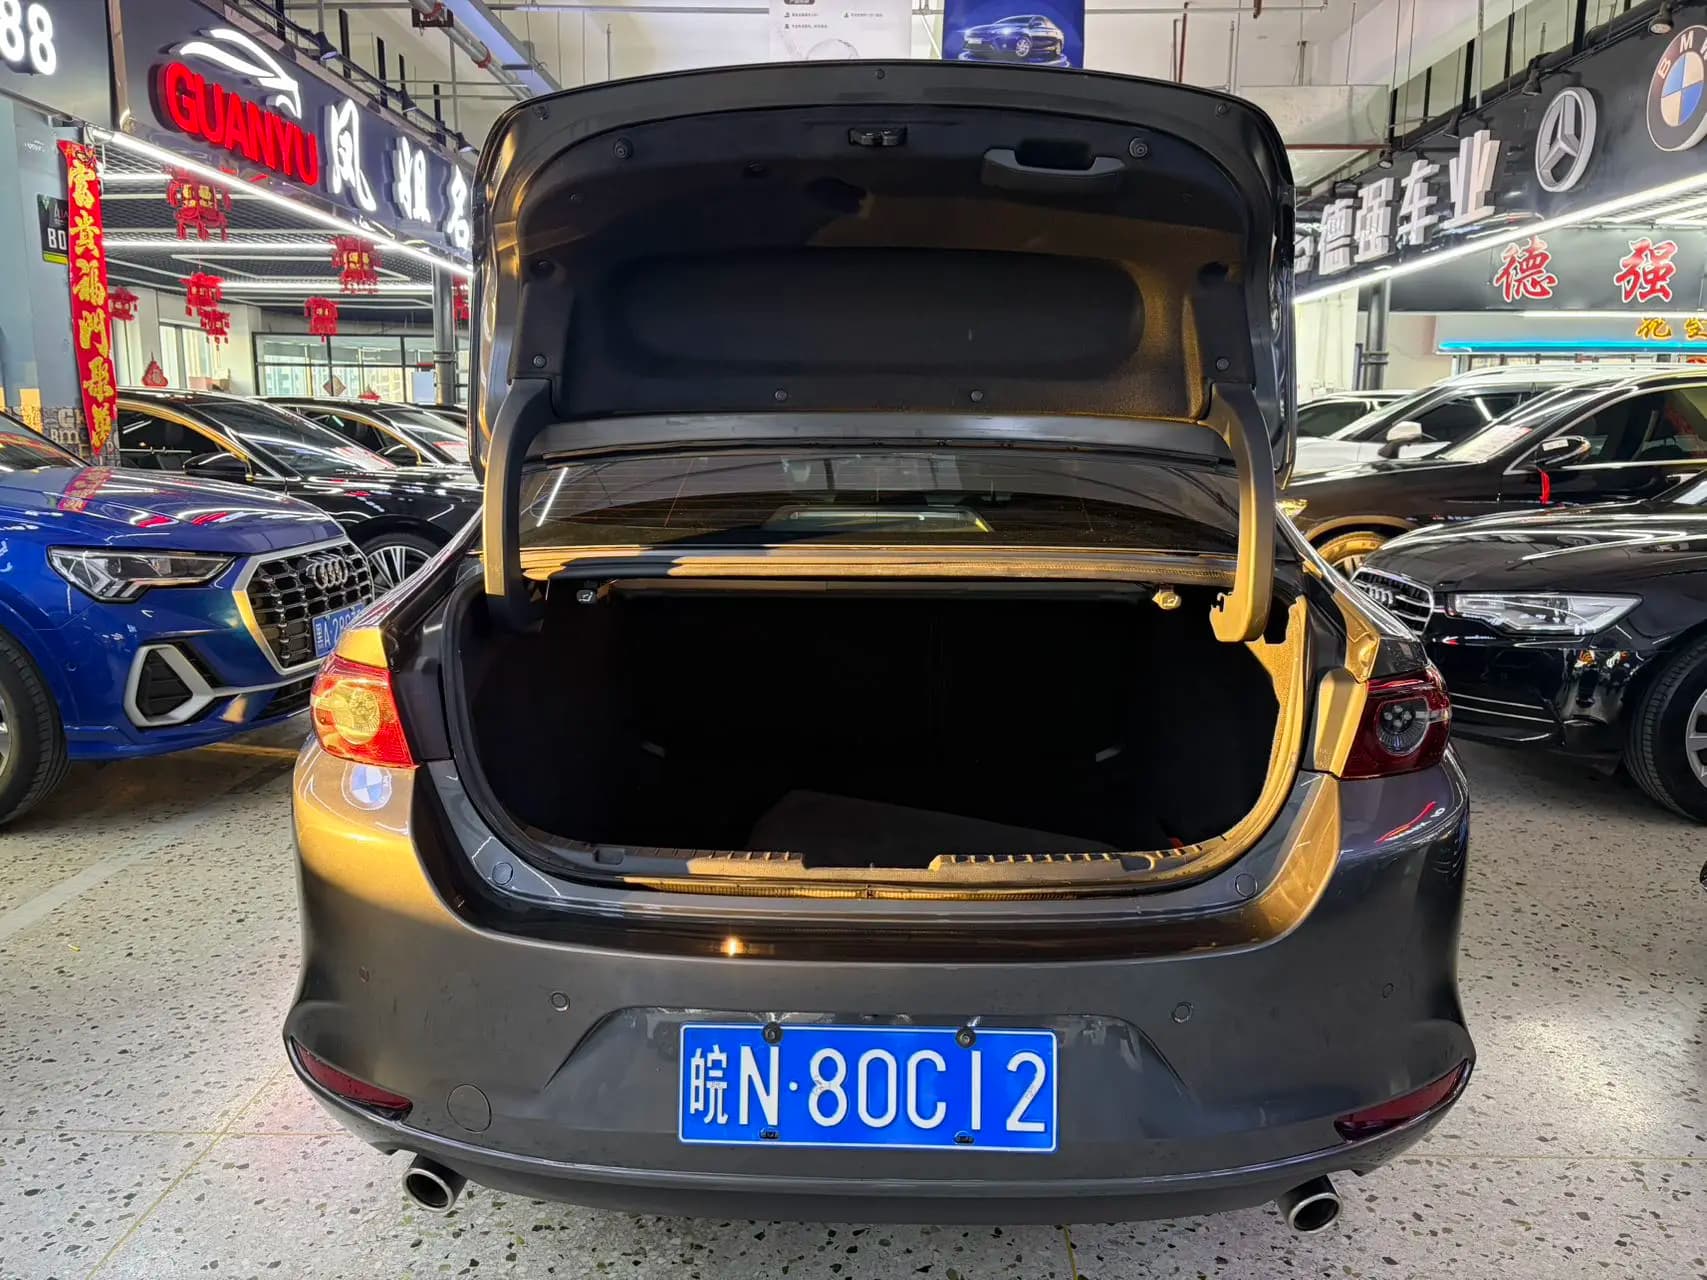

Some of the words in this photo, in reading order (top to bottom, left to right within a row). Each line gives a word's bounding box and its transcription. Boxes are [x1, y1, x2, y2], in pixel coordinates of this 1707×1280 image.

[165, 62, 318, 186] GUANYU
[1493, 235, 1678, 303] 德强
[689, 1044, 1047, 1133] 皖N·80C12
